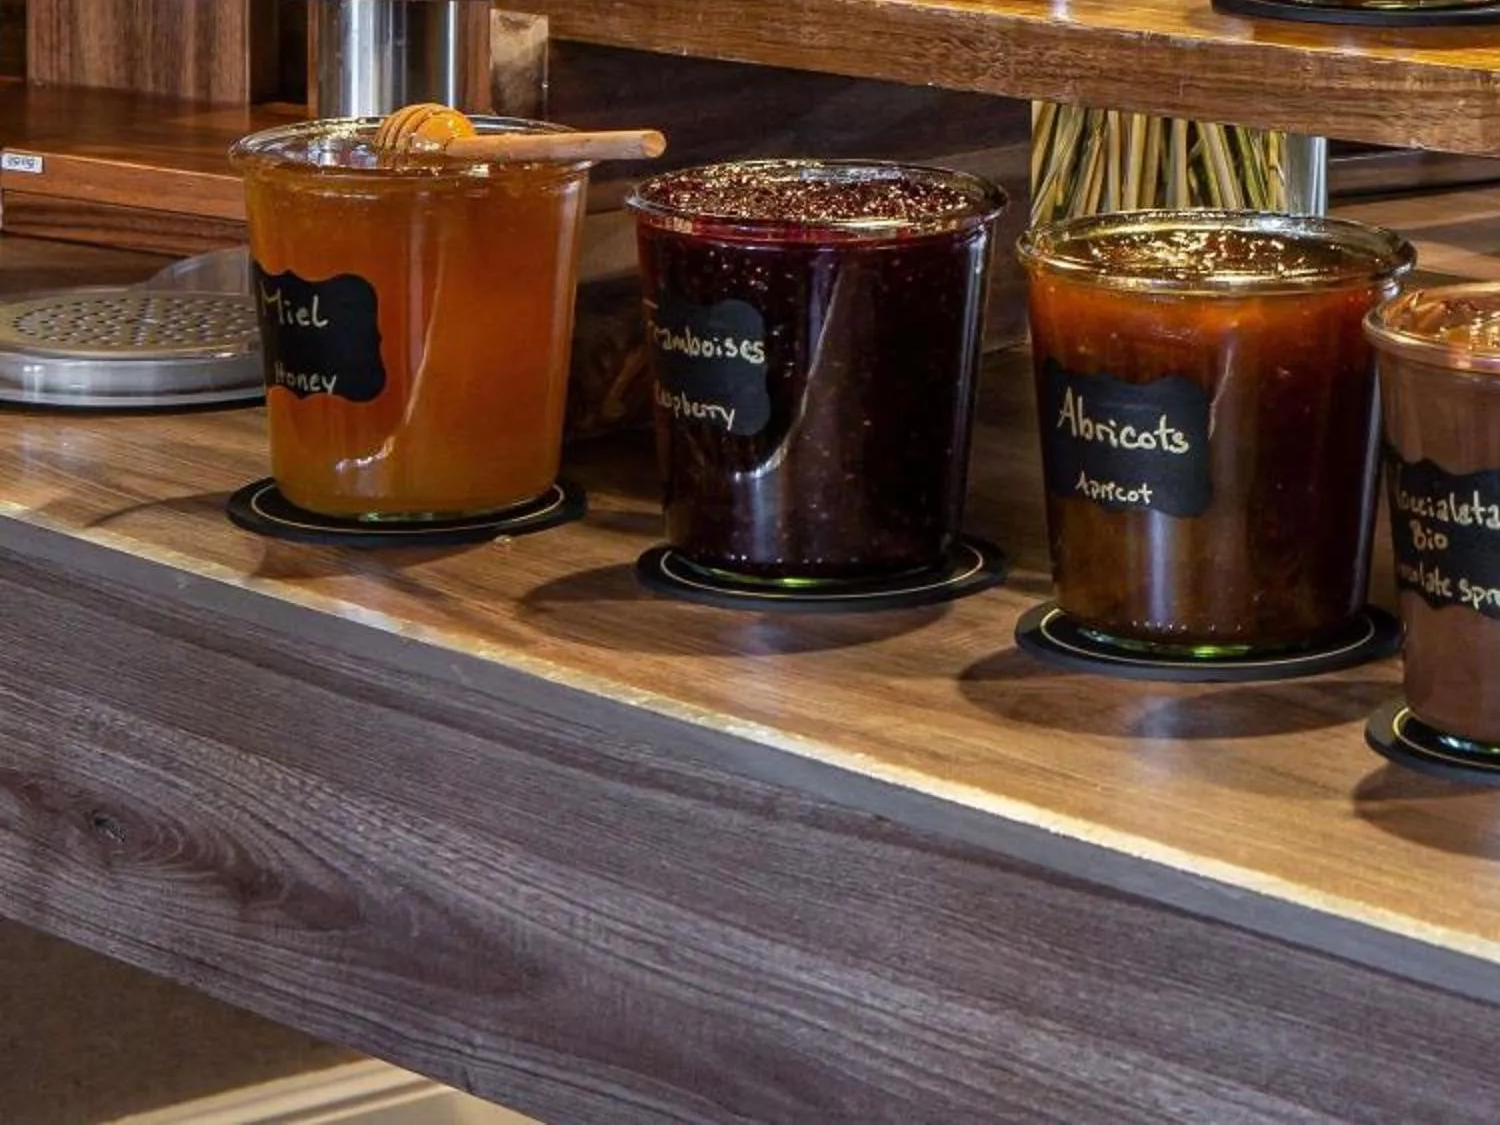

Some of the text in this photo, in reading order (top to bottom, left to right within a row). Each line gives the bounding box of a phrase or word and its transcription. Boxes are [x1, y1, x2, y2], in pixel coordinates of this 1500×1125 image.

[260, 279, 329, 328] Miel
[1056, 386, 1190, 454] Abricots
[1075, 470, 1153, 504] Apricot
